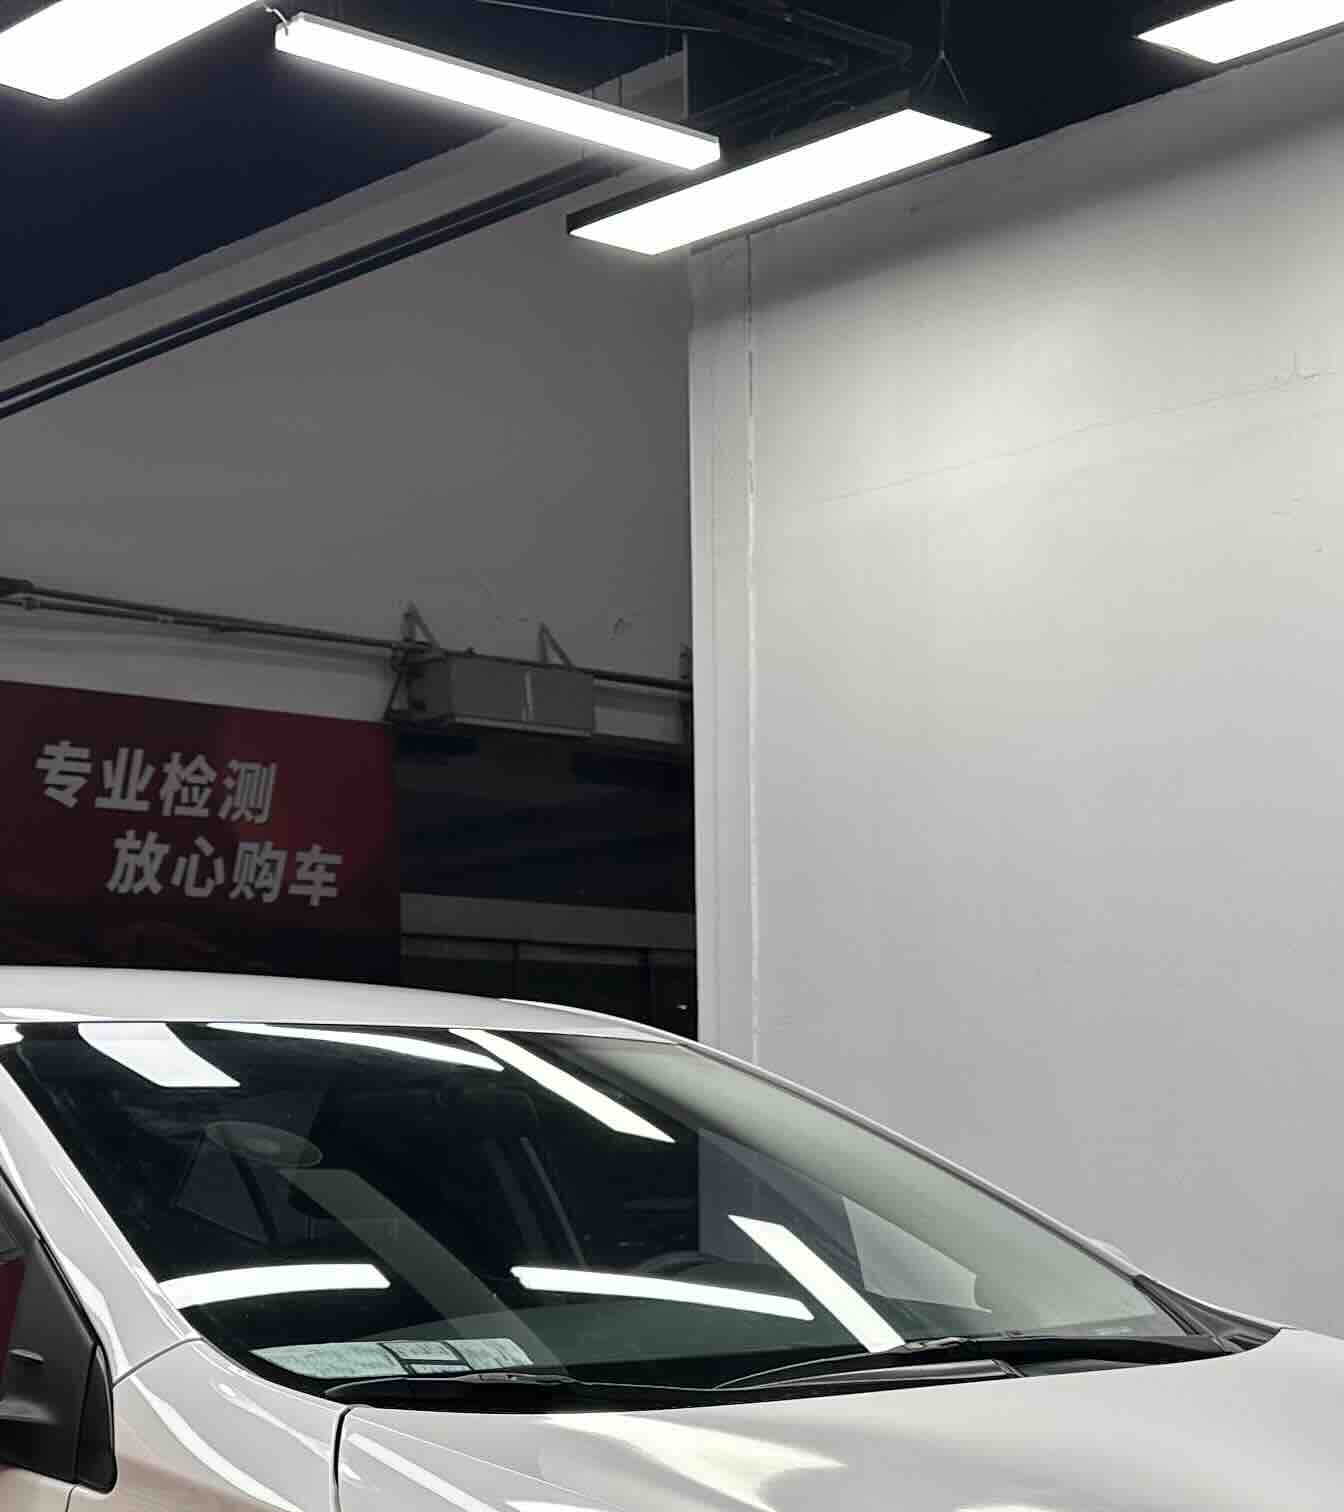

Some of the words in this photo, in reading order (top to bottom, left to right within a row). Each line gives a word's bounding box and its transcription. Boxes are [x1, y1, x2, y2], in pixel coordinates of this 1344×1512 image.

[34, 740, 279, 825] 专业检测
[106, 829, 344, 907] 放心购车
